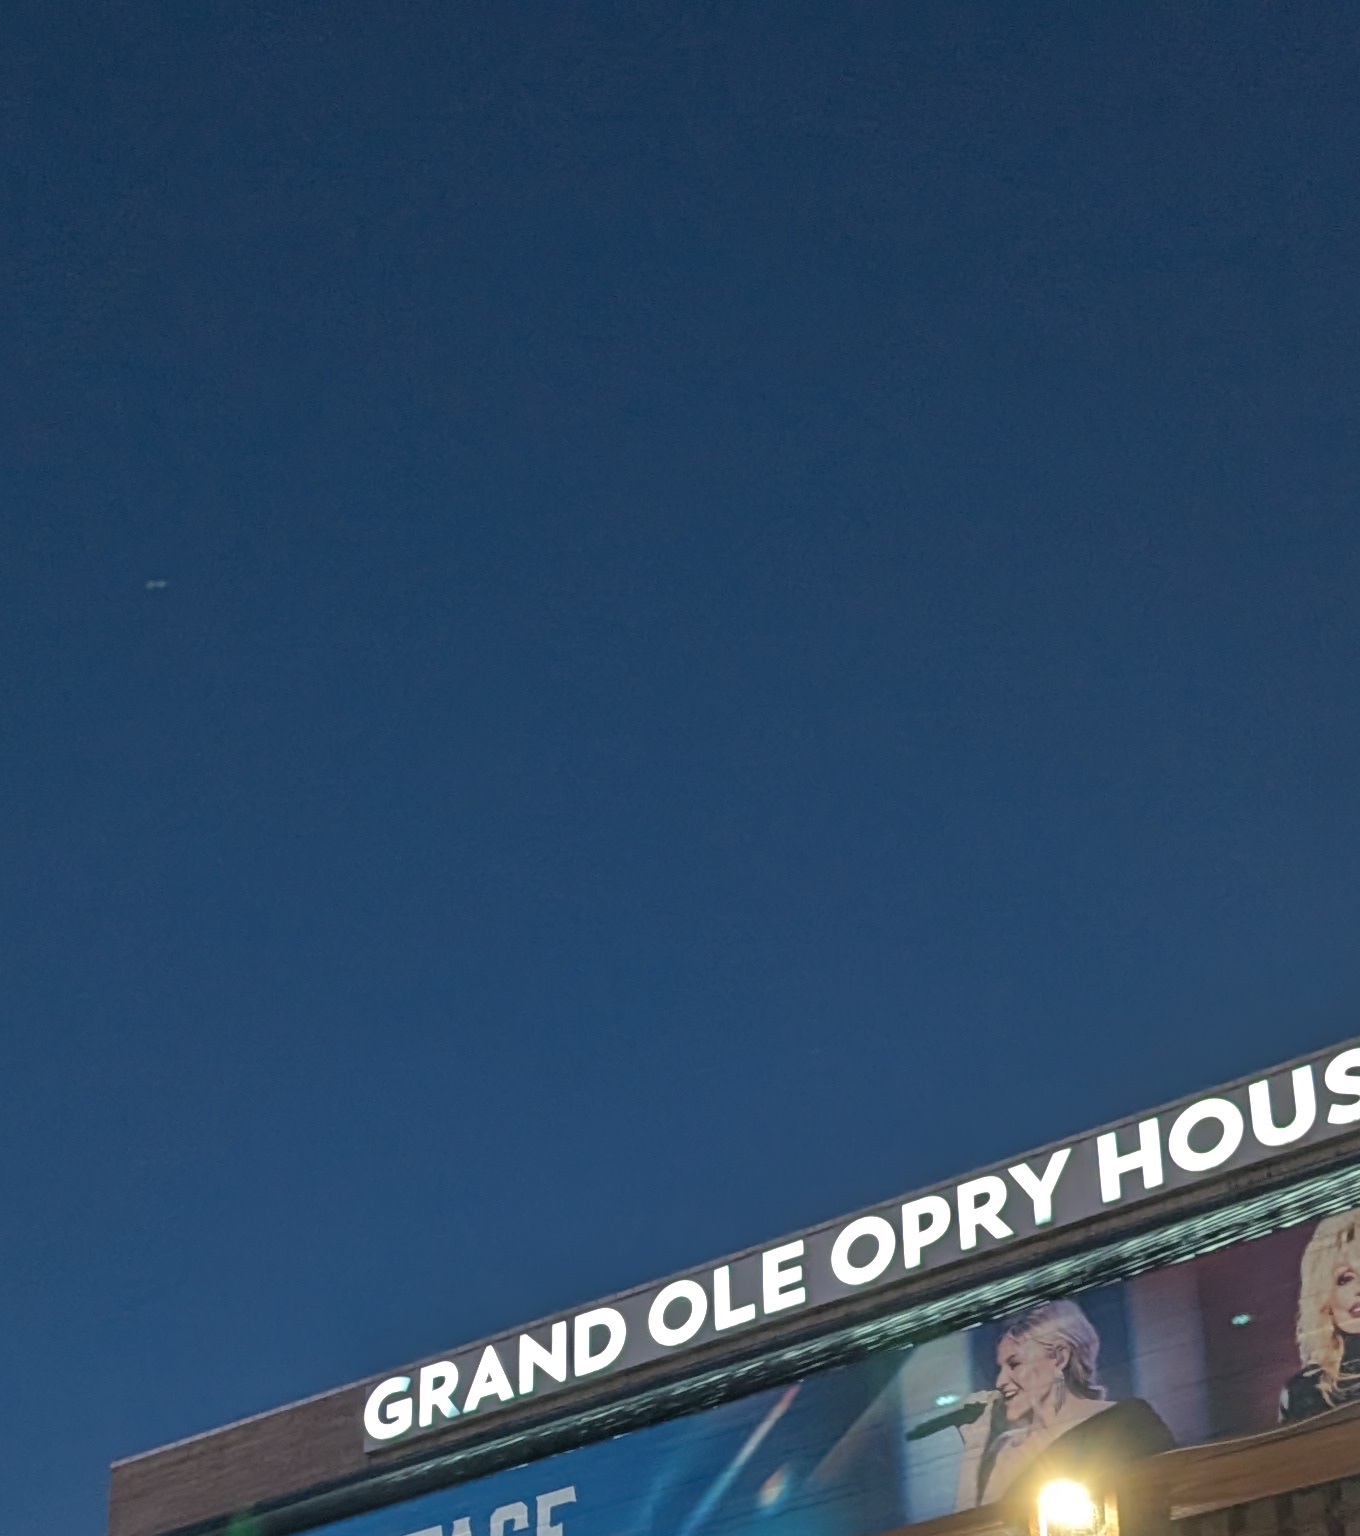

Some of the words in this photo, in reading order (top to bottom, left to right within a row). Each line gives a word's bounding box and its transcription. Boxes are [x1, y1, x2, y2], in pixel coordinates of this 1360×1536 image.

[363, 1307, 627, 1440] GRAND
[648, 1239, 806, 1347] OLE
[830, 1148, 1071, 1286] OPRY
